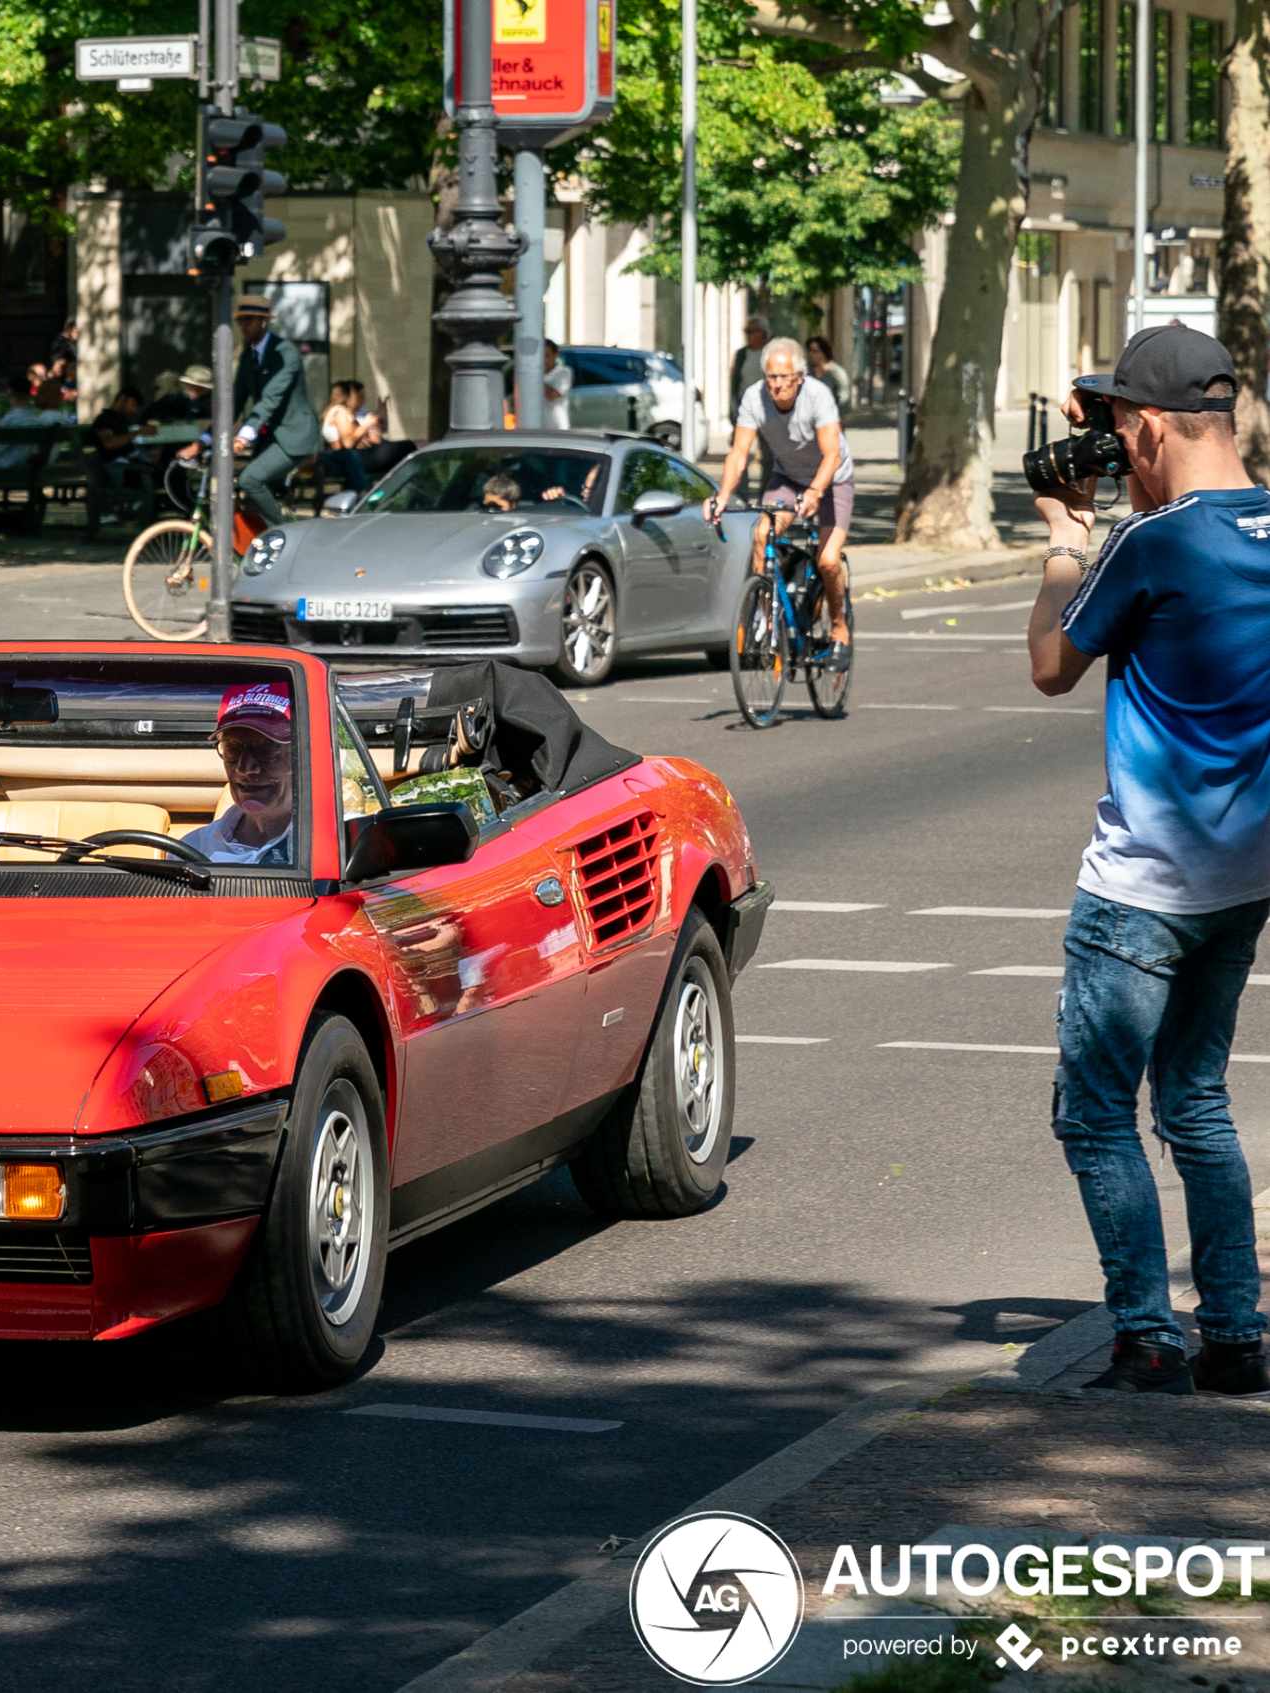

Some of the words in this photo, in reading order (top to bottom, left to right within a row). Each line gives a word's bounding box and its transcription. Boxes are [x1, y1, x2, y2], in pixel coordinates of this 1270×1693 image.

[89, 47, 182, 68] Schlüterstraße
[491, 58, 520, 73] ller
[521, 58, 534, 73] &
[491, 76, 564, 91] chnauck
[307, 601, 324, 617] EU
[355, 602, 389, 618] 1216
[244, 693, 291, 706] OLDTIMER
